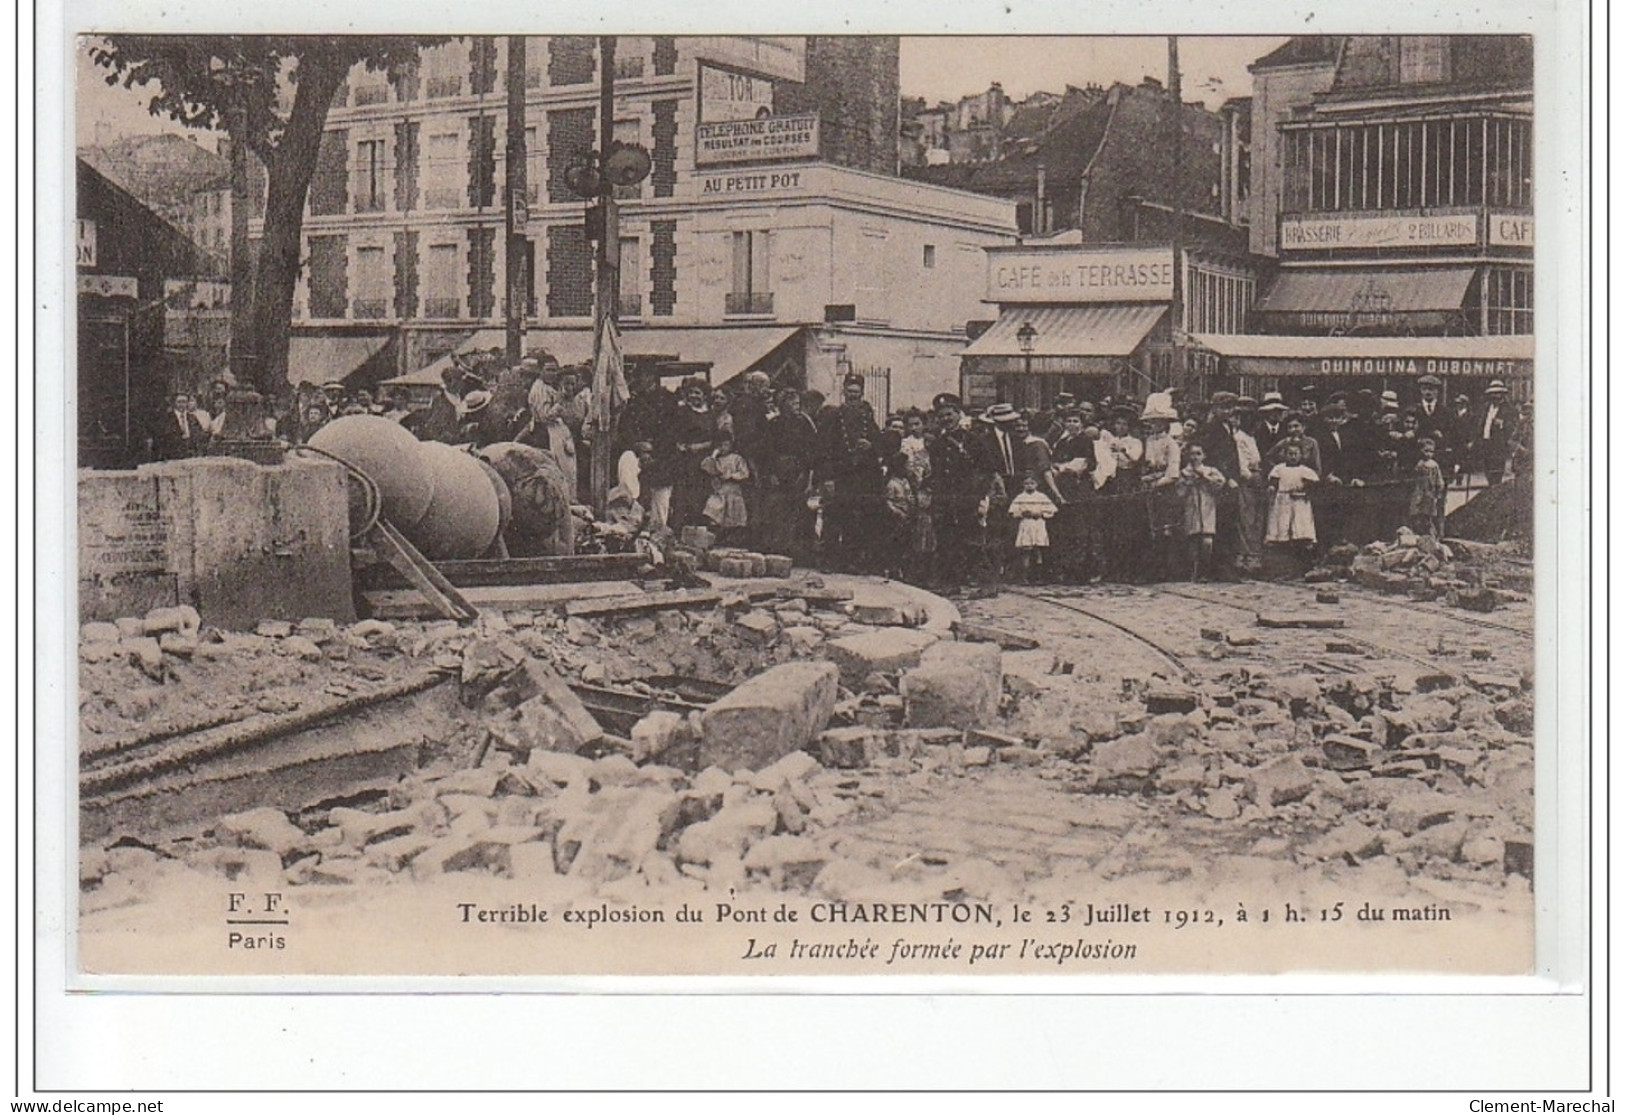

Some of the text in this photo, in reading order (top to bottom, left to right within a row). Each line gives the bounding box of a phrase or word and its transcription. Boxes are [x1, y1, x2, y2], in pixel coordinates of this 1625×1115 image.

[704, 172, 800, 192] AU PETIT POT
[1285, 225, 1340, 243] BRASSERIE
[1078, 263, 1171, 287] TERRASSE
[1427, 359, 1514, 374] DUBONNET
